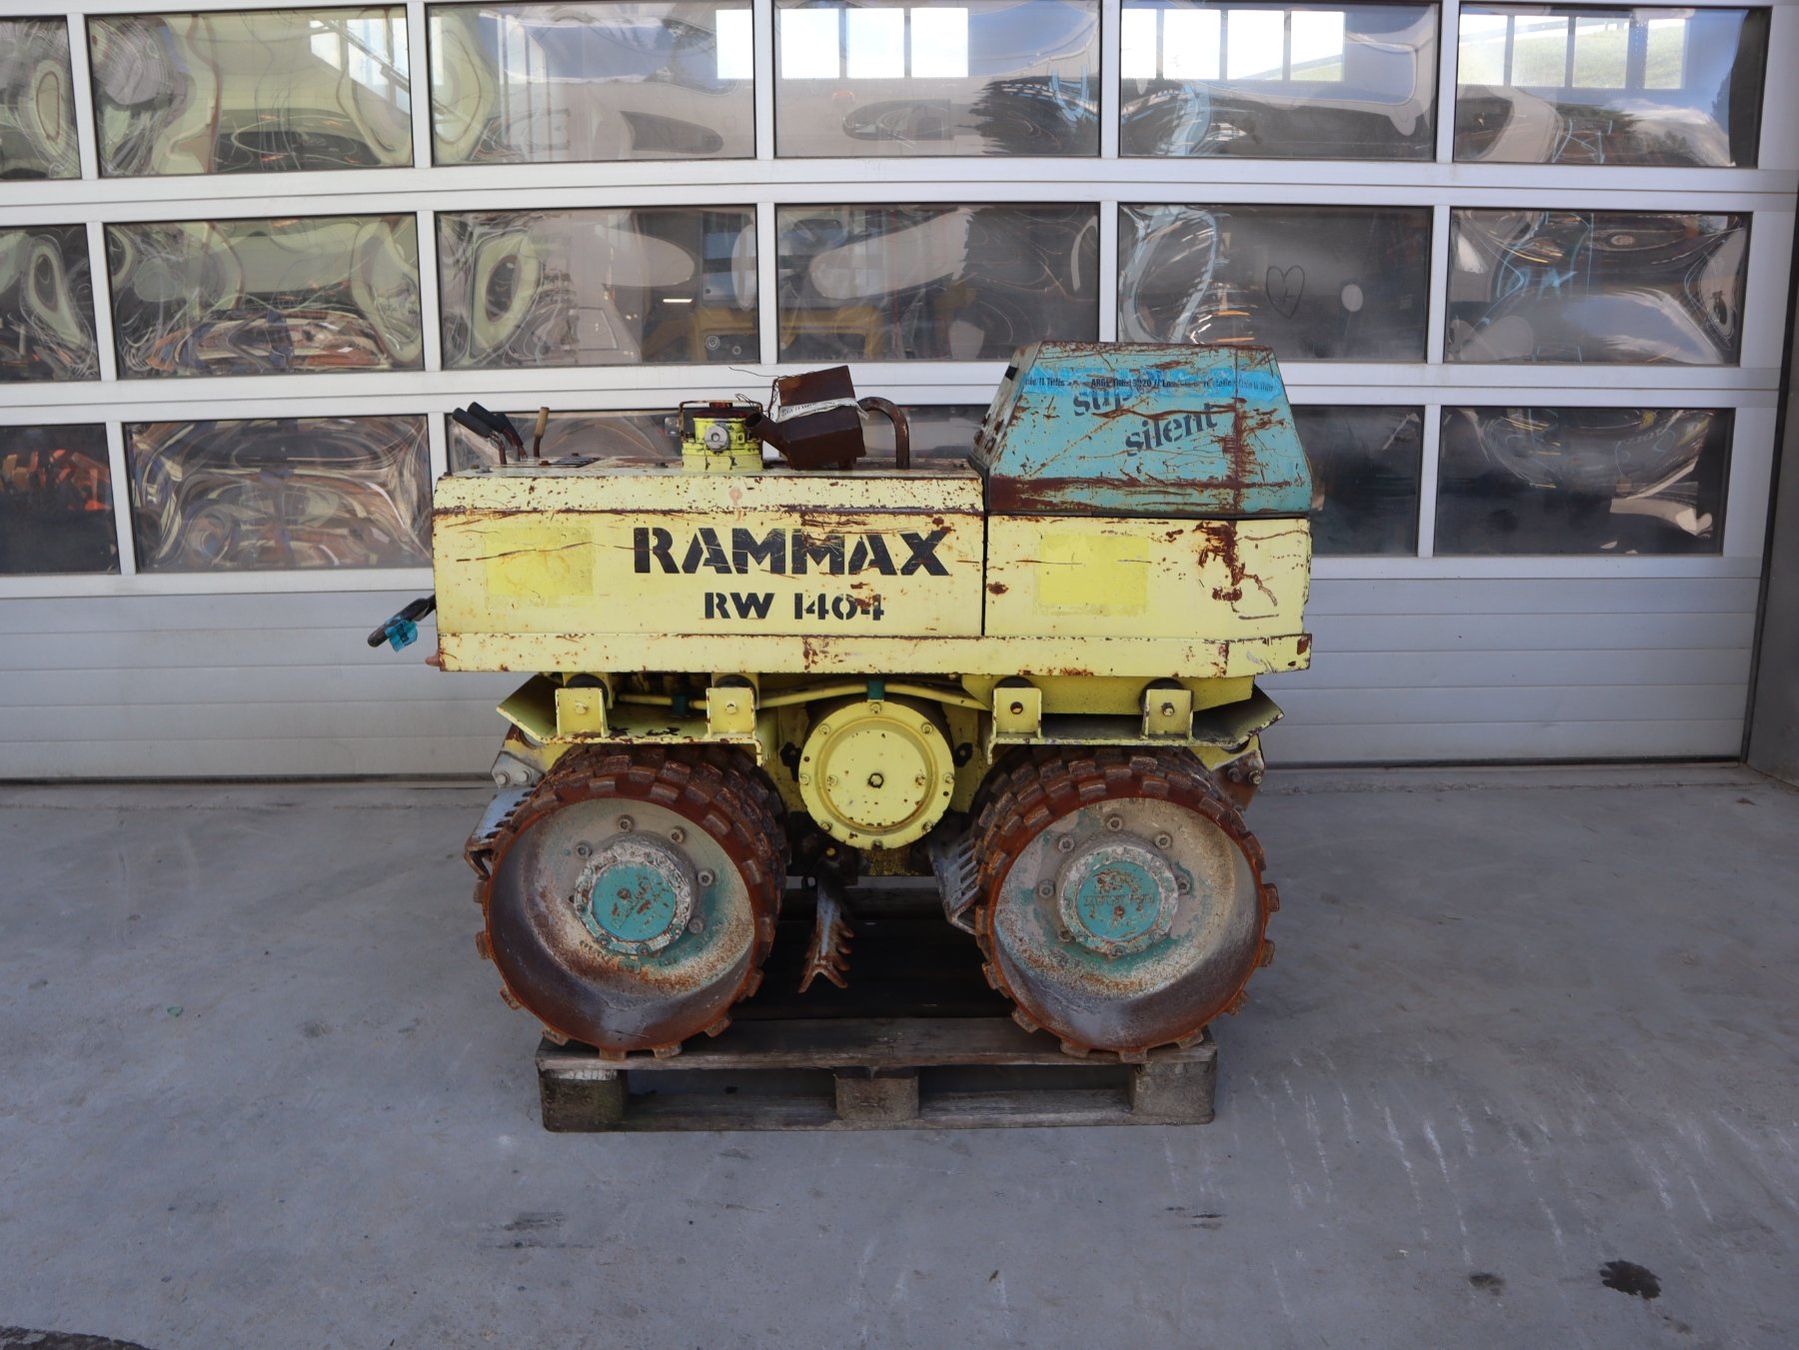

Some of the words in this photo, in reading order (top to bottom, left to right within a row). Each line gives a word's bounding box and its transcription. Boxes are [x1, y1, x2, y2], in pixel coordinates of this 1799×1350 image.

[1125, 402, 1217, 457] silent
[633, 527, 950, 576] RAMMAX
[704, 592, 775, 619] RW
[794, 592, 884, 621] 1404
